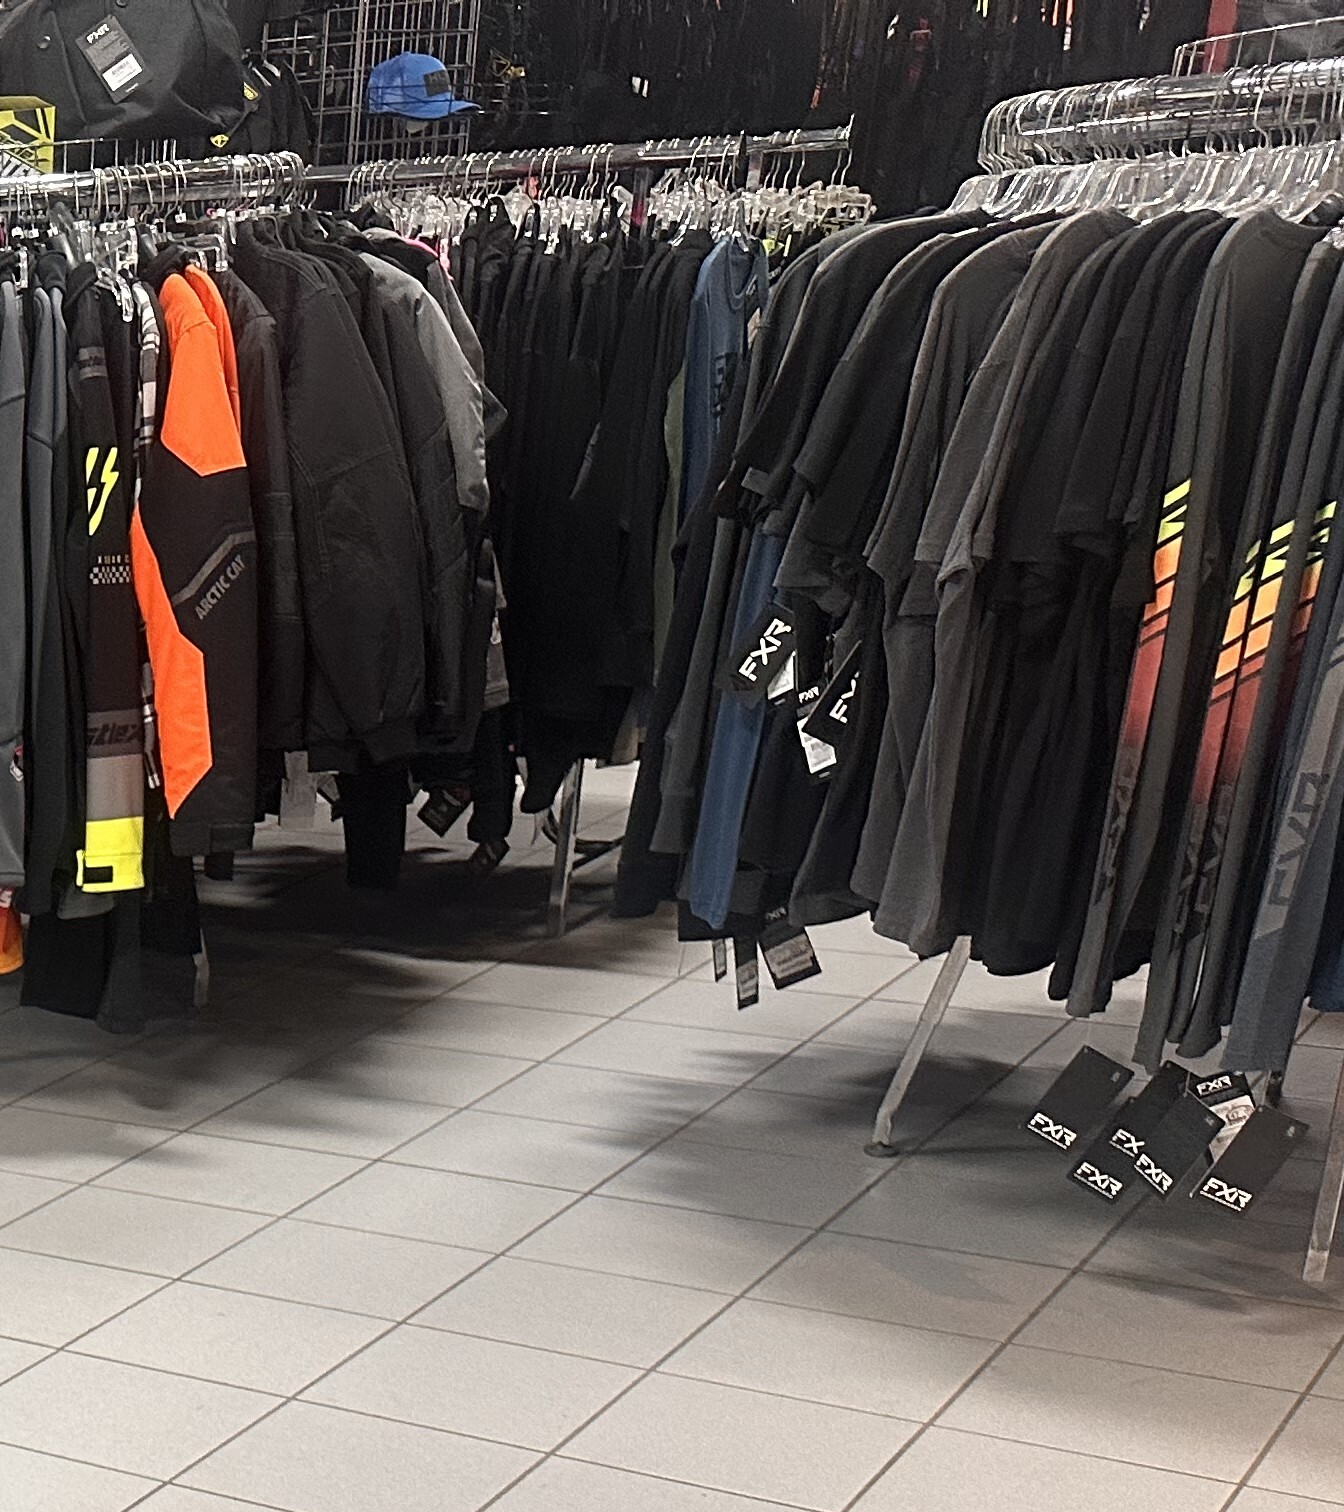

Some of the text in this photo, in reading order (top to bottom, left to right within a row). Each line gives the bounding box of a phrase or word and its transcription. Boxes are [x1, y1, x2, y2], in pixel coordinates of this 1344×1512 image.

[86, 24, 110, 44] FXR
[194, 554, 247, 621] ARCTIC CAT
[738, 617, 792, 683] FXR
[1197, 1075, 1232, 1096] FXR
[1029, 1111, 1077, 1148] FXR
[1112, 1128, 1145, 1154] FX
[1076, 1161, 1123, 1197] FXR
[1136, 1153, 1174, 1191] FXR
[1202, 1176, 1252, 1208] FXR
